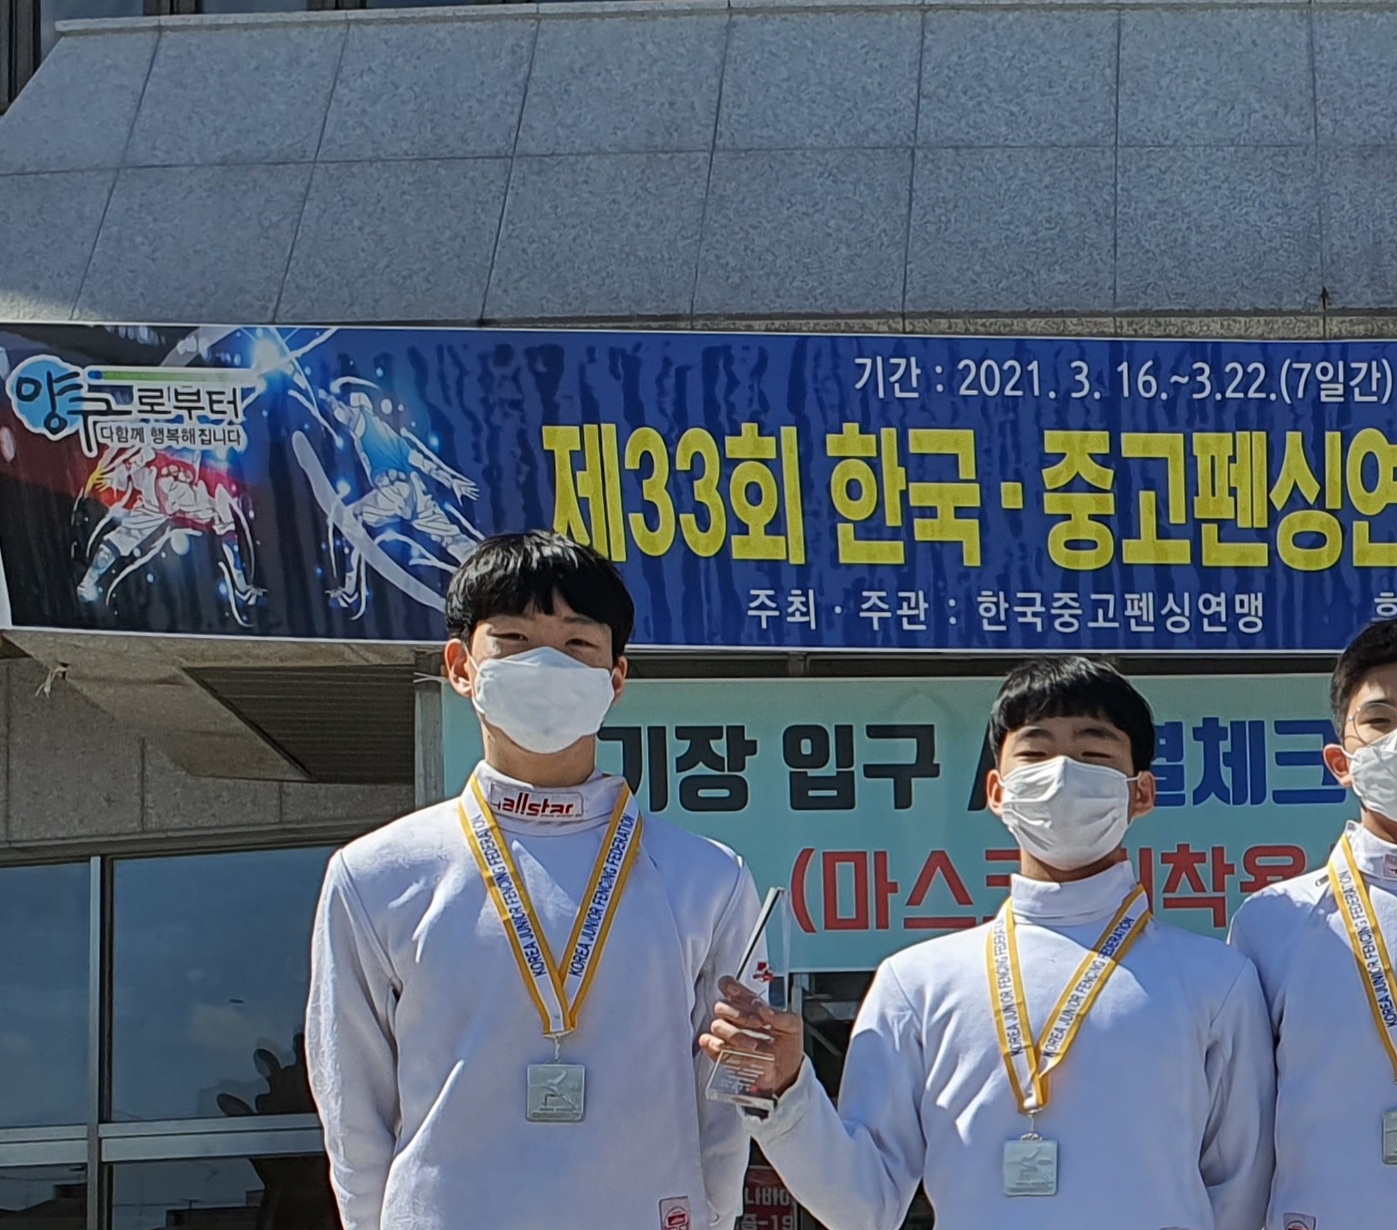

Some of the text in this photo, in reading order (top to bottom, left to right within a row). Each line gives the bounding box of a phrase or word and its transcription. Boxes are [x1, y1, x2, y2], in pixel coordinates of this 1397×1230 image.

[854, 355, 921, 399] 기간
[957, 358, 1057, 399] 2021.
[1070, 359, 1101, 399] 3.
[100, 425, 242, 446] 다함께 행복해집니다
[542, 421, 806, 564] 제33회
[747, 588, 817, 630] 주최
[859, 590, 928, 631] 주관
[977, 589, 1265, 634] 한국중고펜싱연맹
[598, 723, 758, 812] 기장
[782, 723, 941, 812] 입구
[502, 792, 574, 816] allstar
[579, 907, 602, 942] JUNIOR
[524, 941, 547, 978] KOREA
[568, 941, 592, 978] KOREA
[1043, 916, 1135, 1058] KOREA JUNIOR FENCING FEDERATION
[1006, 1024, 1024, 1057] KOREA
